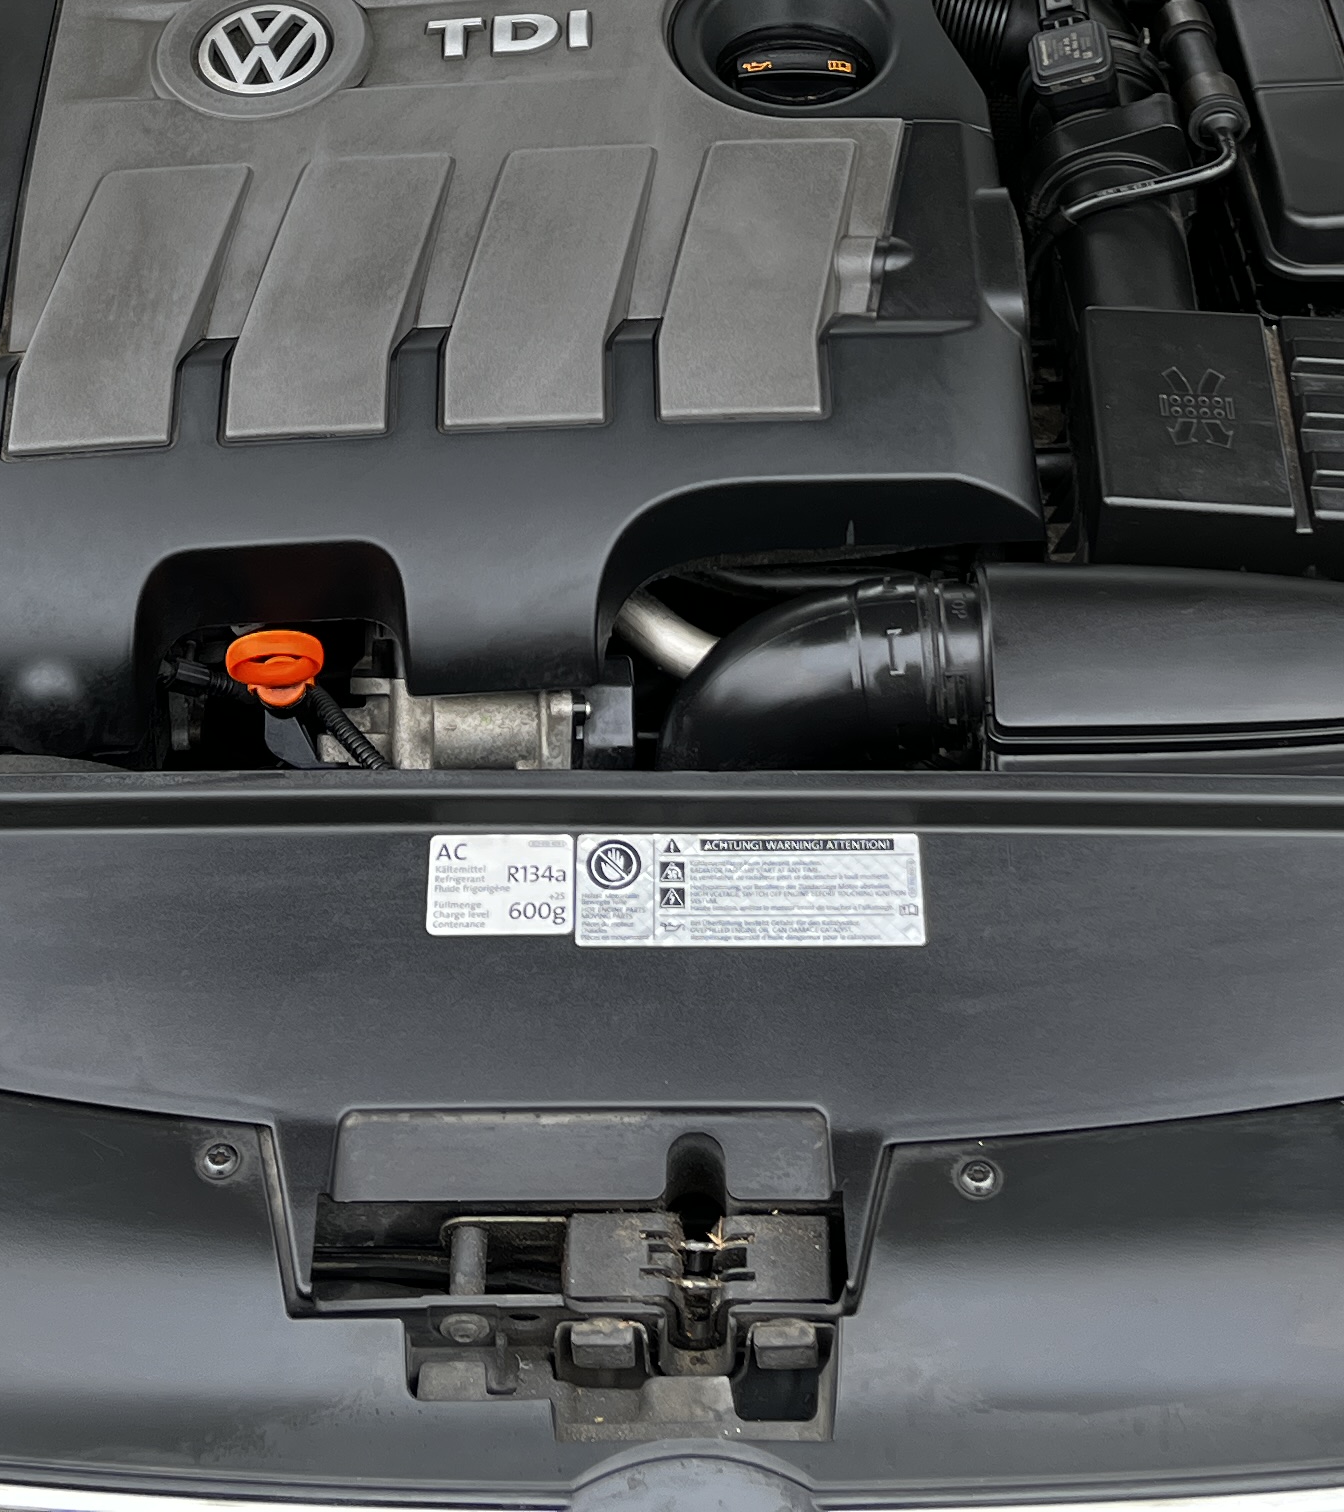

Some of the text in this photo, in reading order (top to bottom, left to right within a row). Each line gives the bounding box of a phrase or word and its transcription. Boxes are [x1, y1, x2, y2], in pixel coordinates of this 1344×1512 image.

[425, 8, 593, 62] TDI
[198, 4, 327, 94] VW
[703, 839, 891, 851] ACHTUNG! WARNING! ATTENTION!
[435, 843, 468, 861] AC
[435, 865, 487, 874] Kältemittel
[506, 864, 567, 883] R134a
[434, 875, 486, 886] Refrigerant
[433, 884, 461, 893] Fluide
[433, 900, 482, 911] Füllmenge
[432, 909, 490, 920] Charge level
[508, 901, 567, 926] 600g
[432, 920, 486, 929] Contenance
